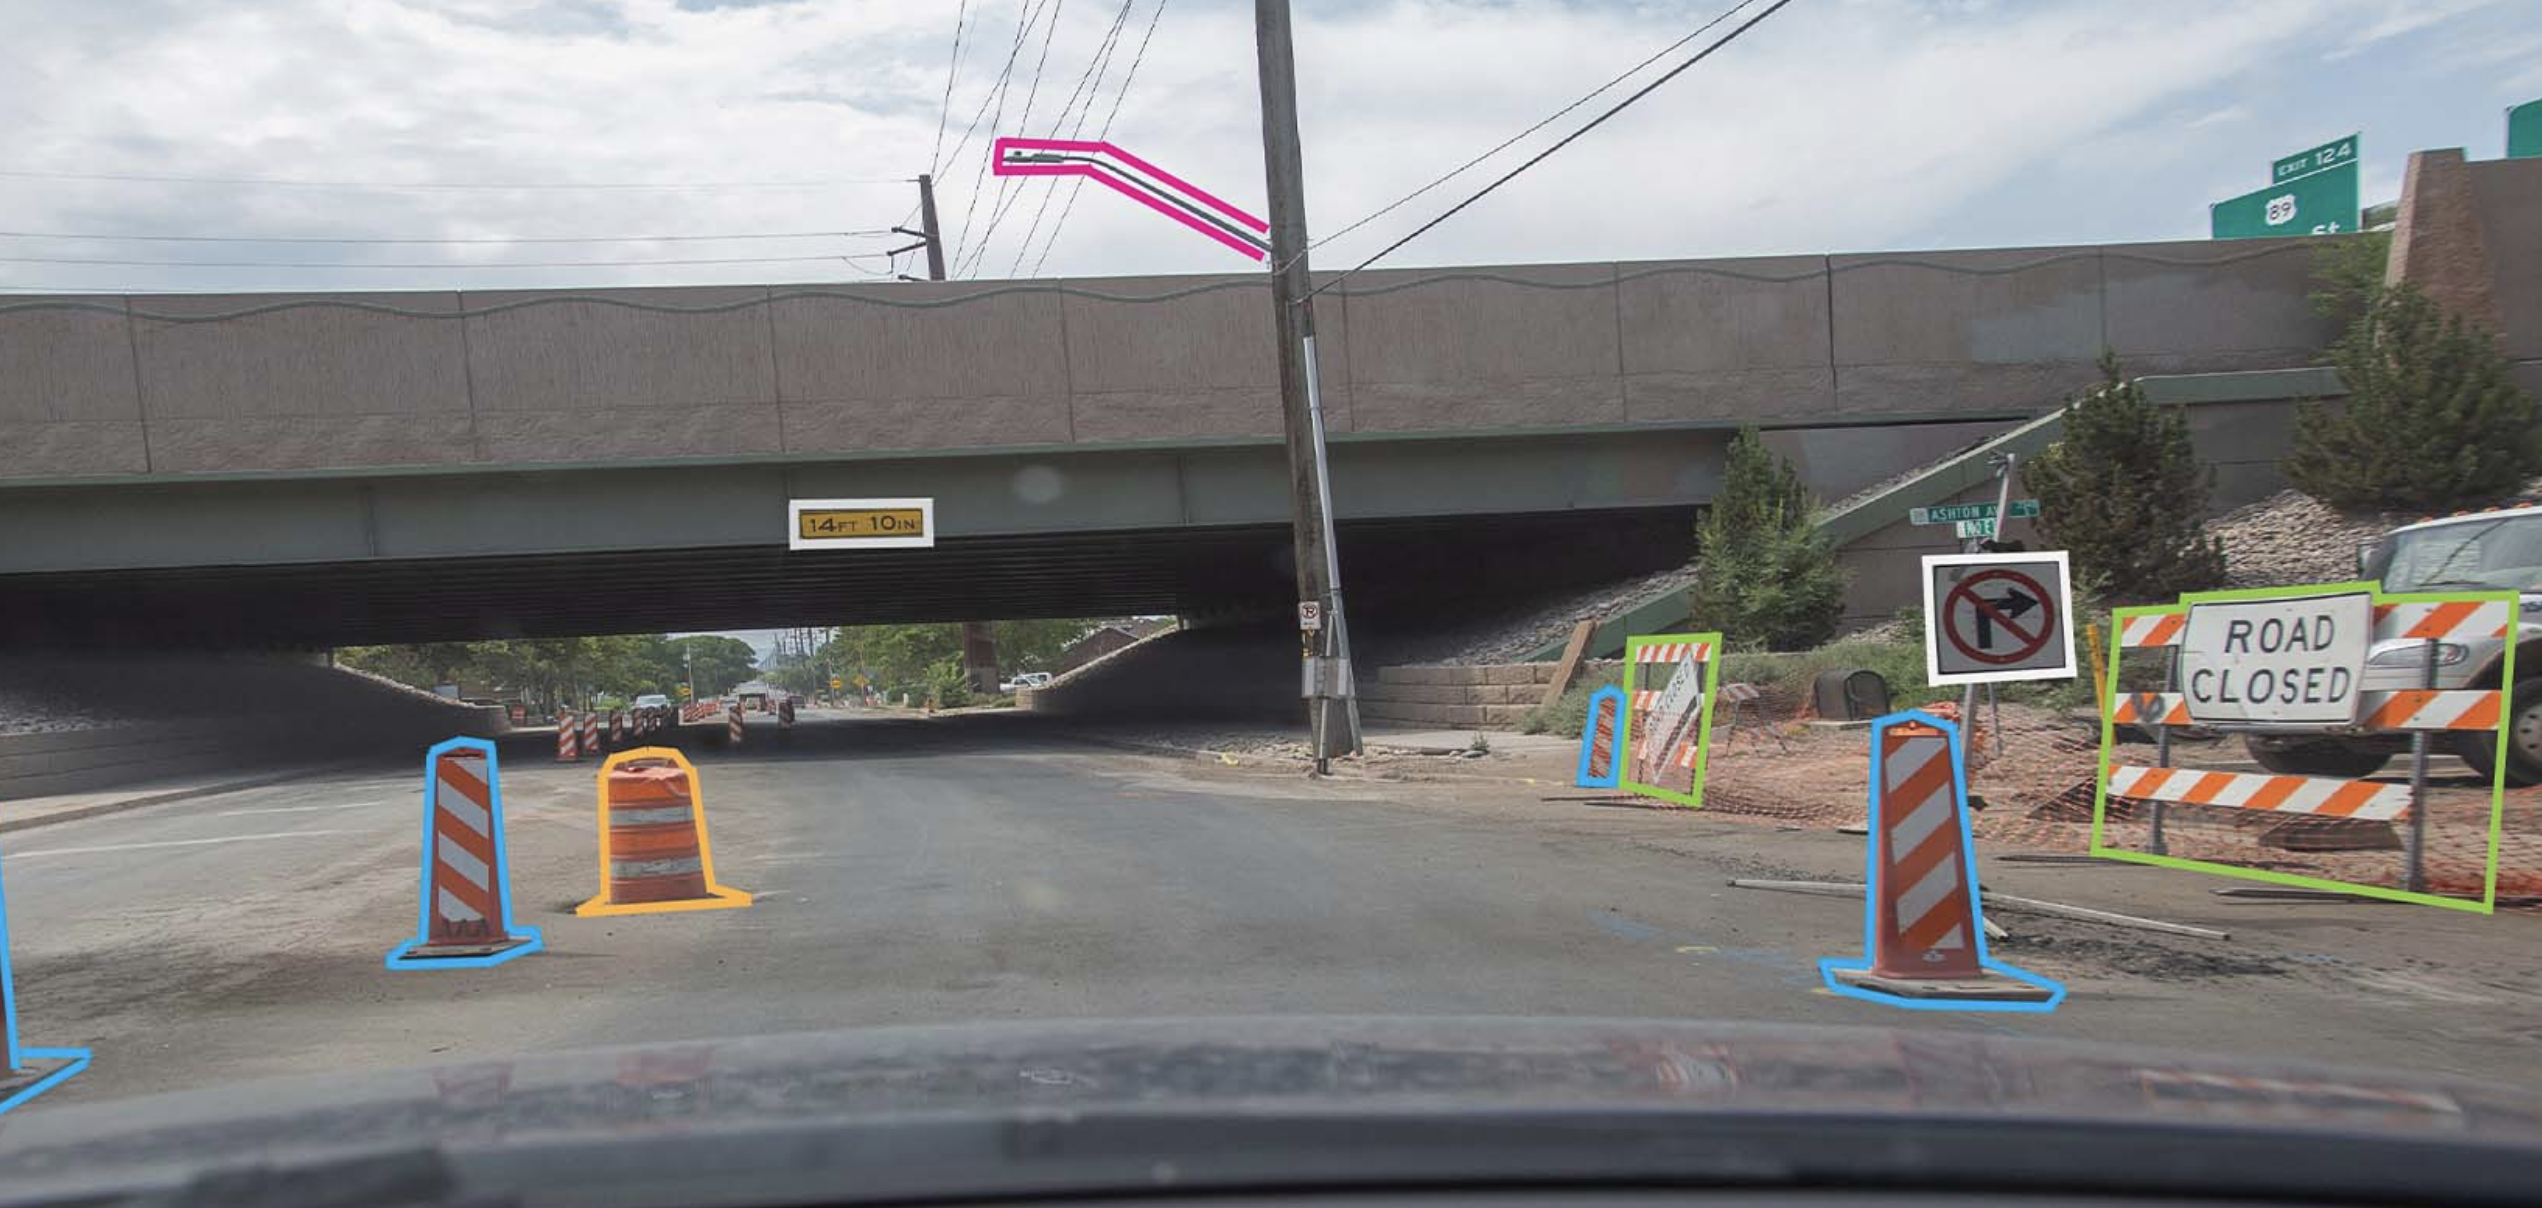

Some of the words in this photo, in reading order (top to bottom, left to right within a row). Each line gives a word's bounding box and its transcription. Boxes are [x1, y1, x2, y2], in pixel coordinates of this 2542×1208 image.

[2278, 158, 2309, 177] EXIT
[2315, 142, 2351, 166] 124
[2268, 201, 2292, 221] 89
[809, 518, 858, 533] 14FT
[871, 514, 916, 532] 10IN
[1930, 506, 1980, 520] ASHTON
[2224, 615, 2335, 654] ROAD
[2191, 666, 2351, 705] CLOSED
